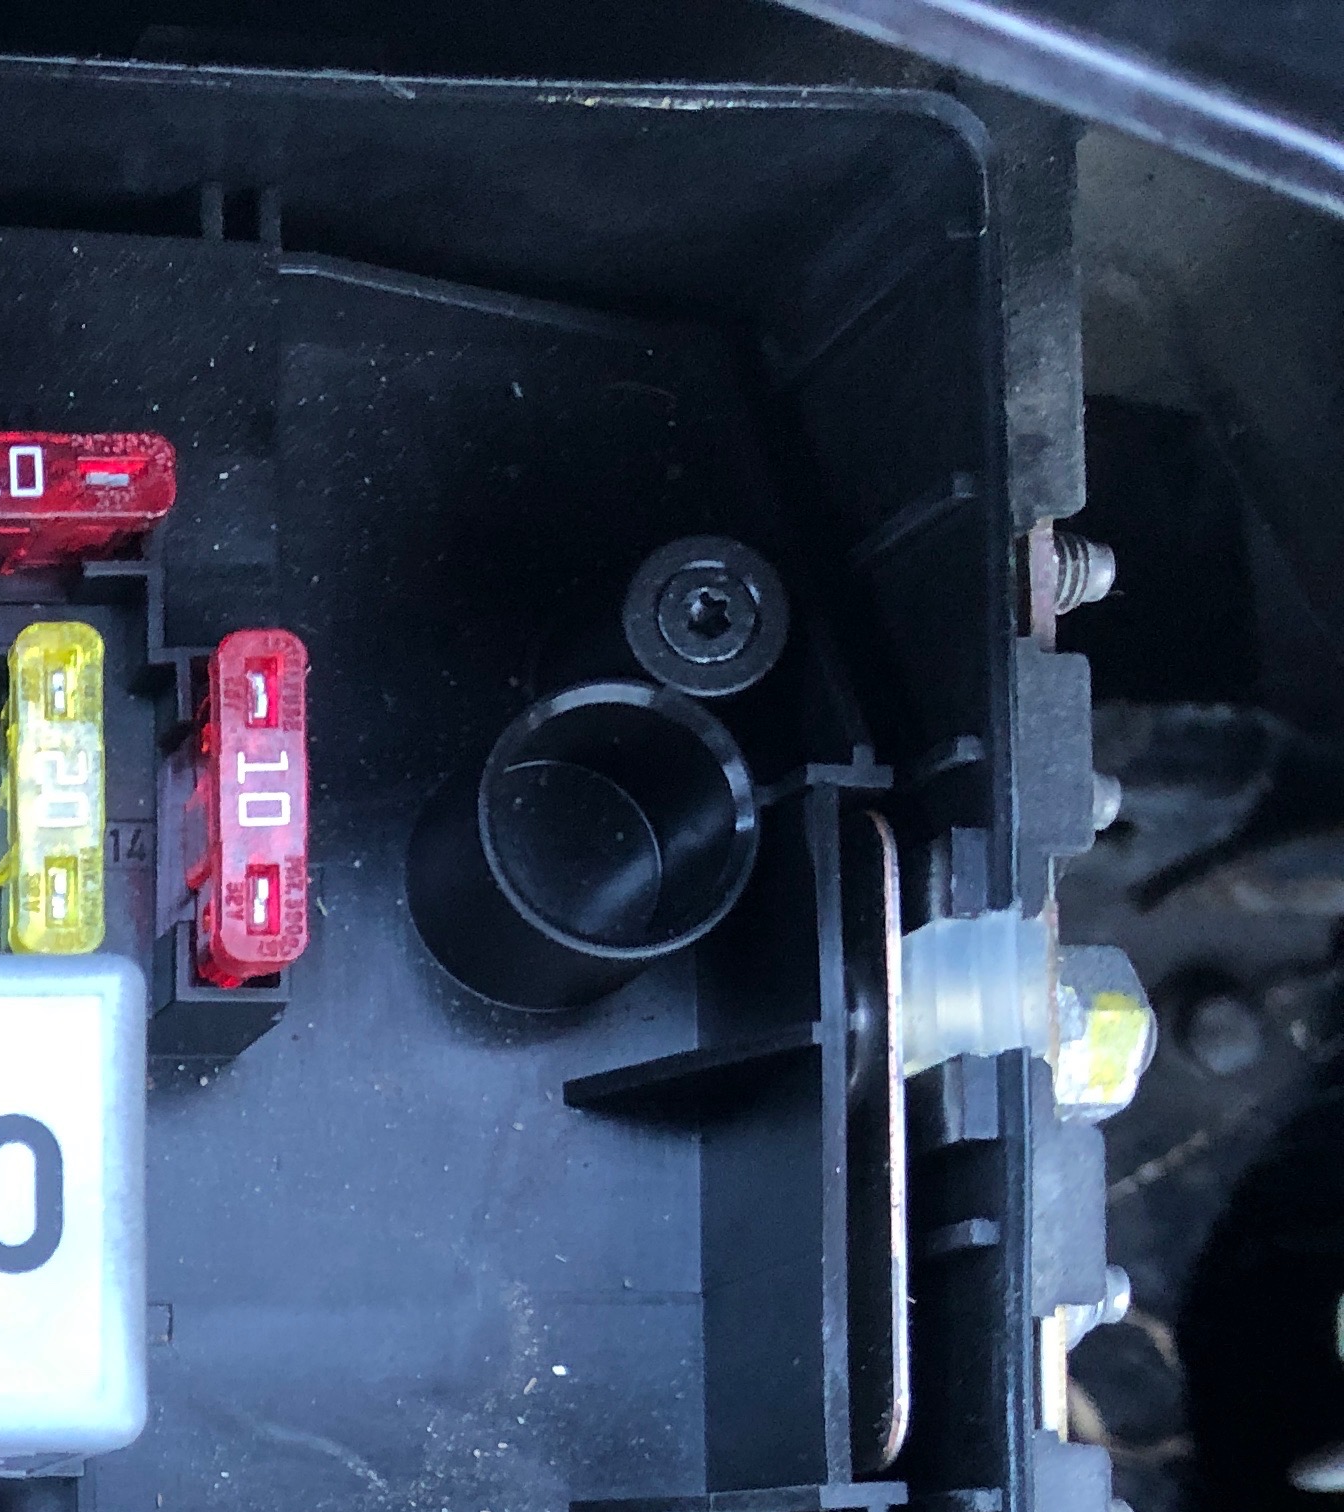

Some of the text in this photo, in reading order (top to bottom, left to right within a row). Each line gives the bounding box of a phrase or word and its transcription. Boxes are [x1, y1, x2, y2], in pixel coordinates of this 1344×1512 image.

[32, 749, 91, 830] 20
[237, 750, 291, 827] 10
[108, 827, 148, 863] 14
[225, 881, 245, 923] 32V
